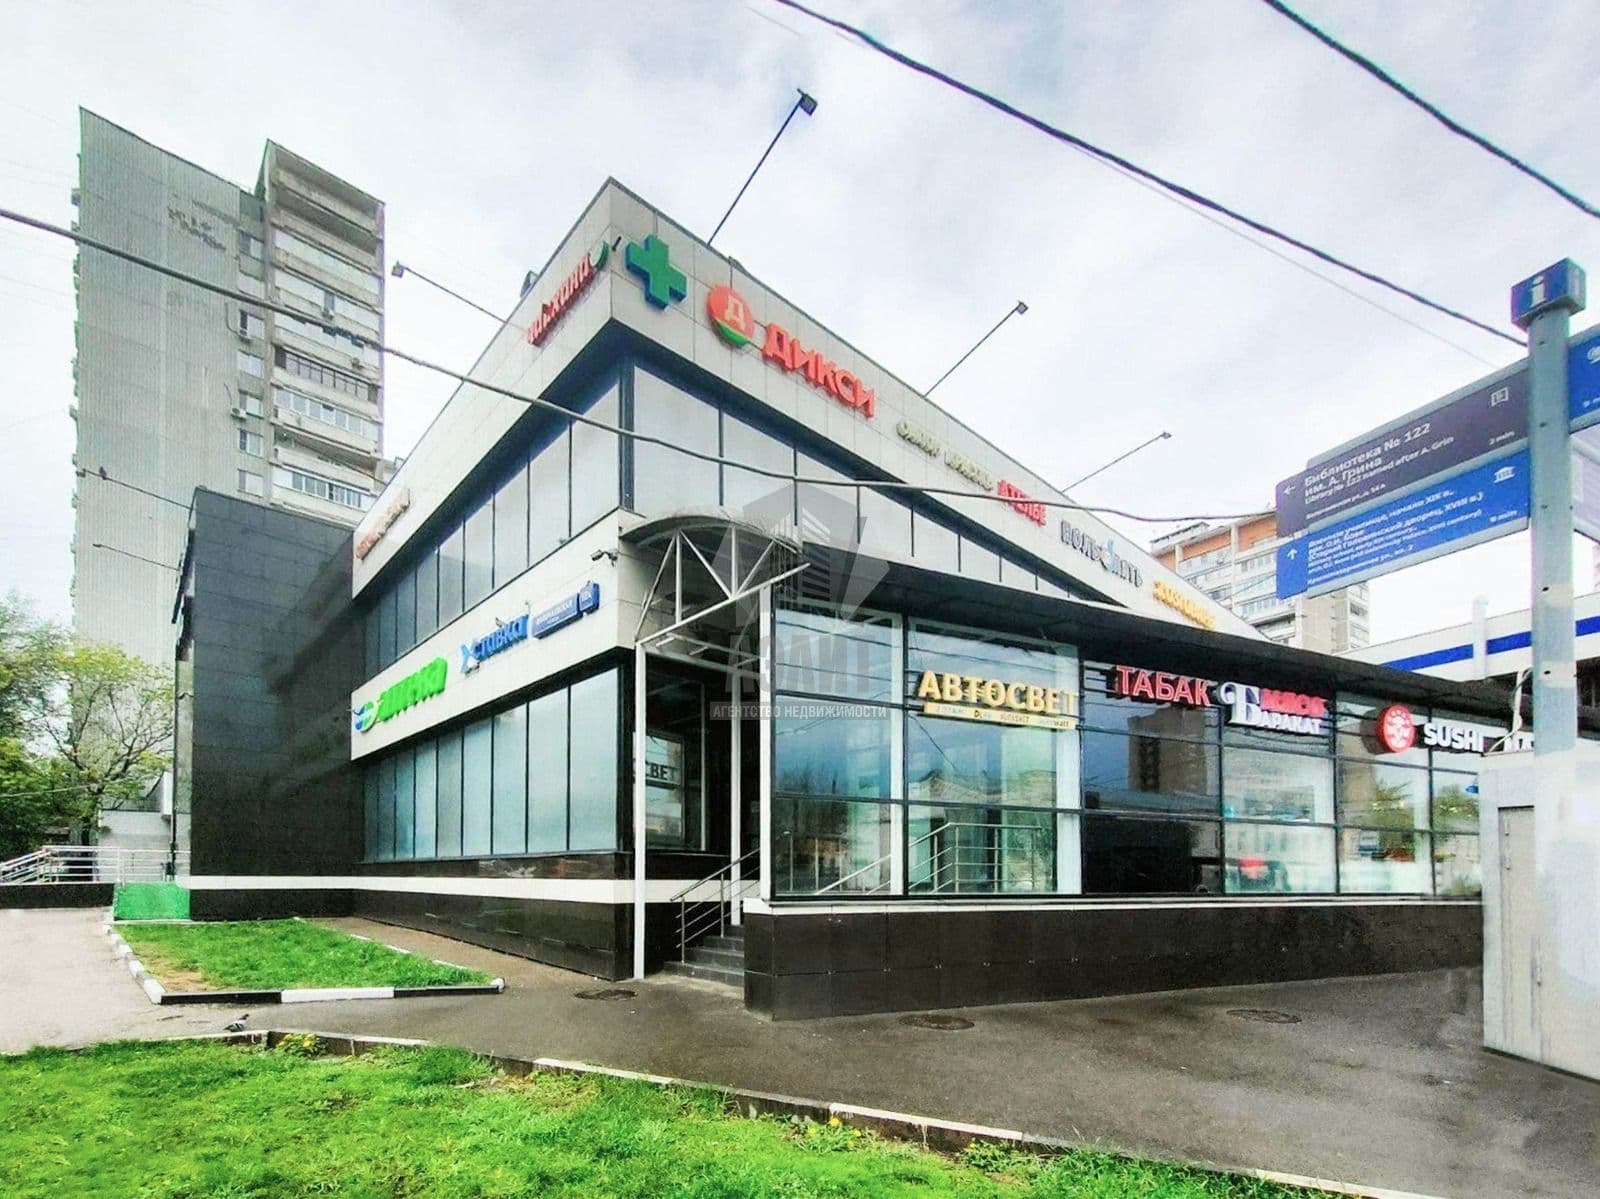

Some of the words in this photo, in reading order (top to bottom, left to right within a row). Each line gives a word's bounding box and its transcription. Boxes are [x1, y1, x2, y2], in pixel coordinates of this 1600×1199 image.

[762, 322, 874, 418] ДИКСИ
[1305, 447, 1381, 487] Библиотека
[1384, 438, 1400, 451] №
[1404, 423, 1431, 443] 122
[1305, 483, 1327, 498] им.
[1342, 458, 1382, 482] Грина
[917, 669, 1080, 715] АВТОСВЕТ
[1116, 664, 1212, 707] ТАБАК
[1220, 682, 1323, 735] БАРАКАТ
[1423, 722, 1484, 752] SUSHI
